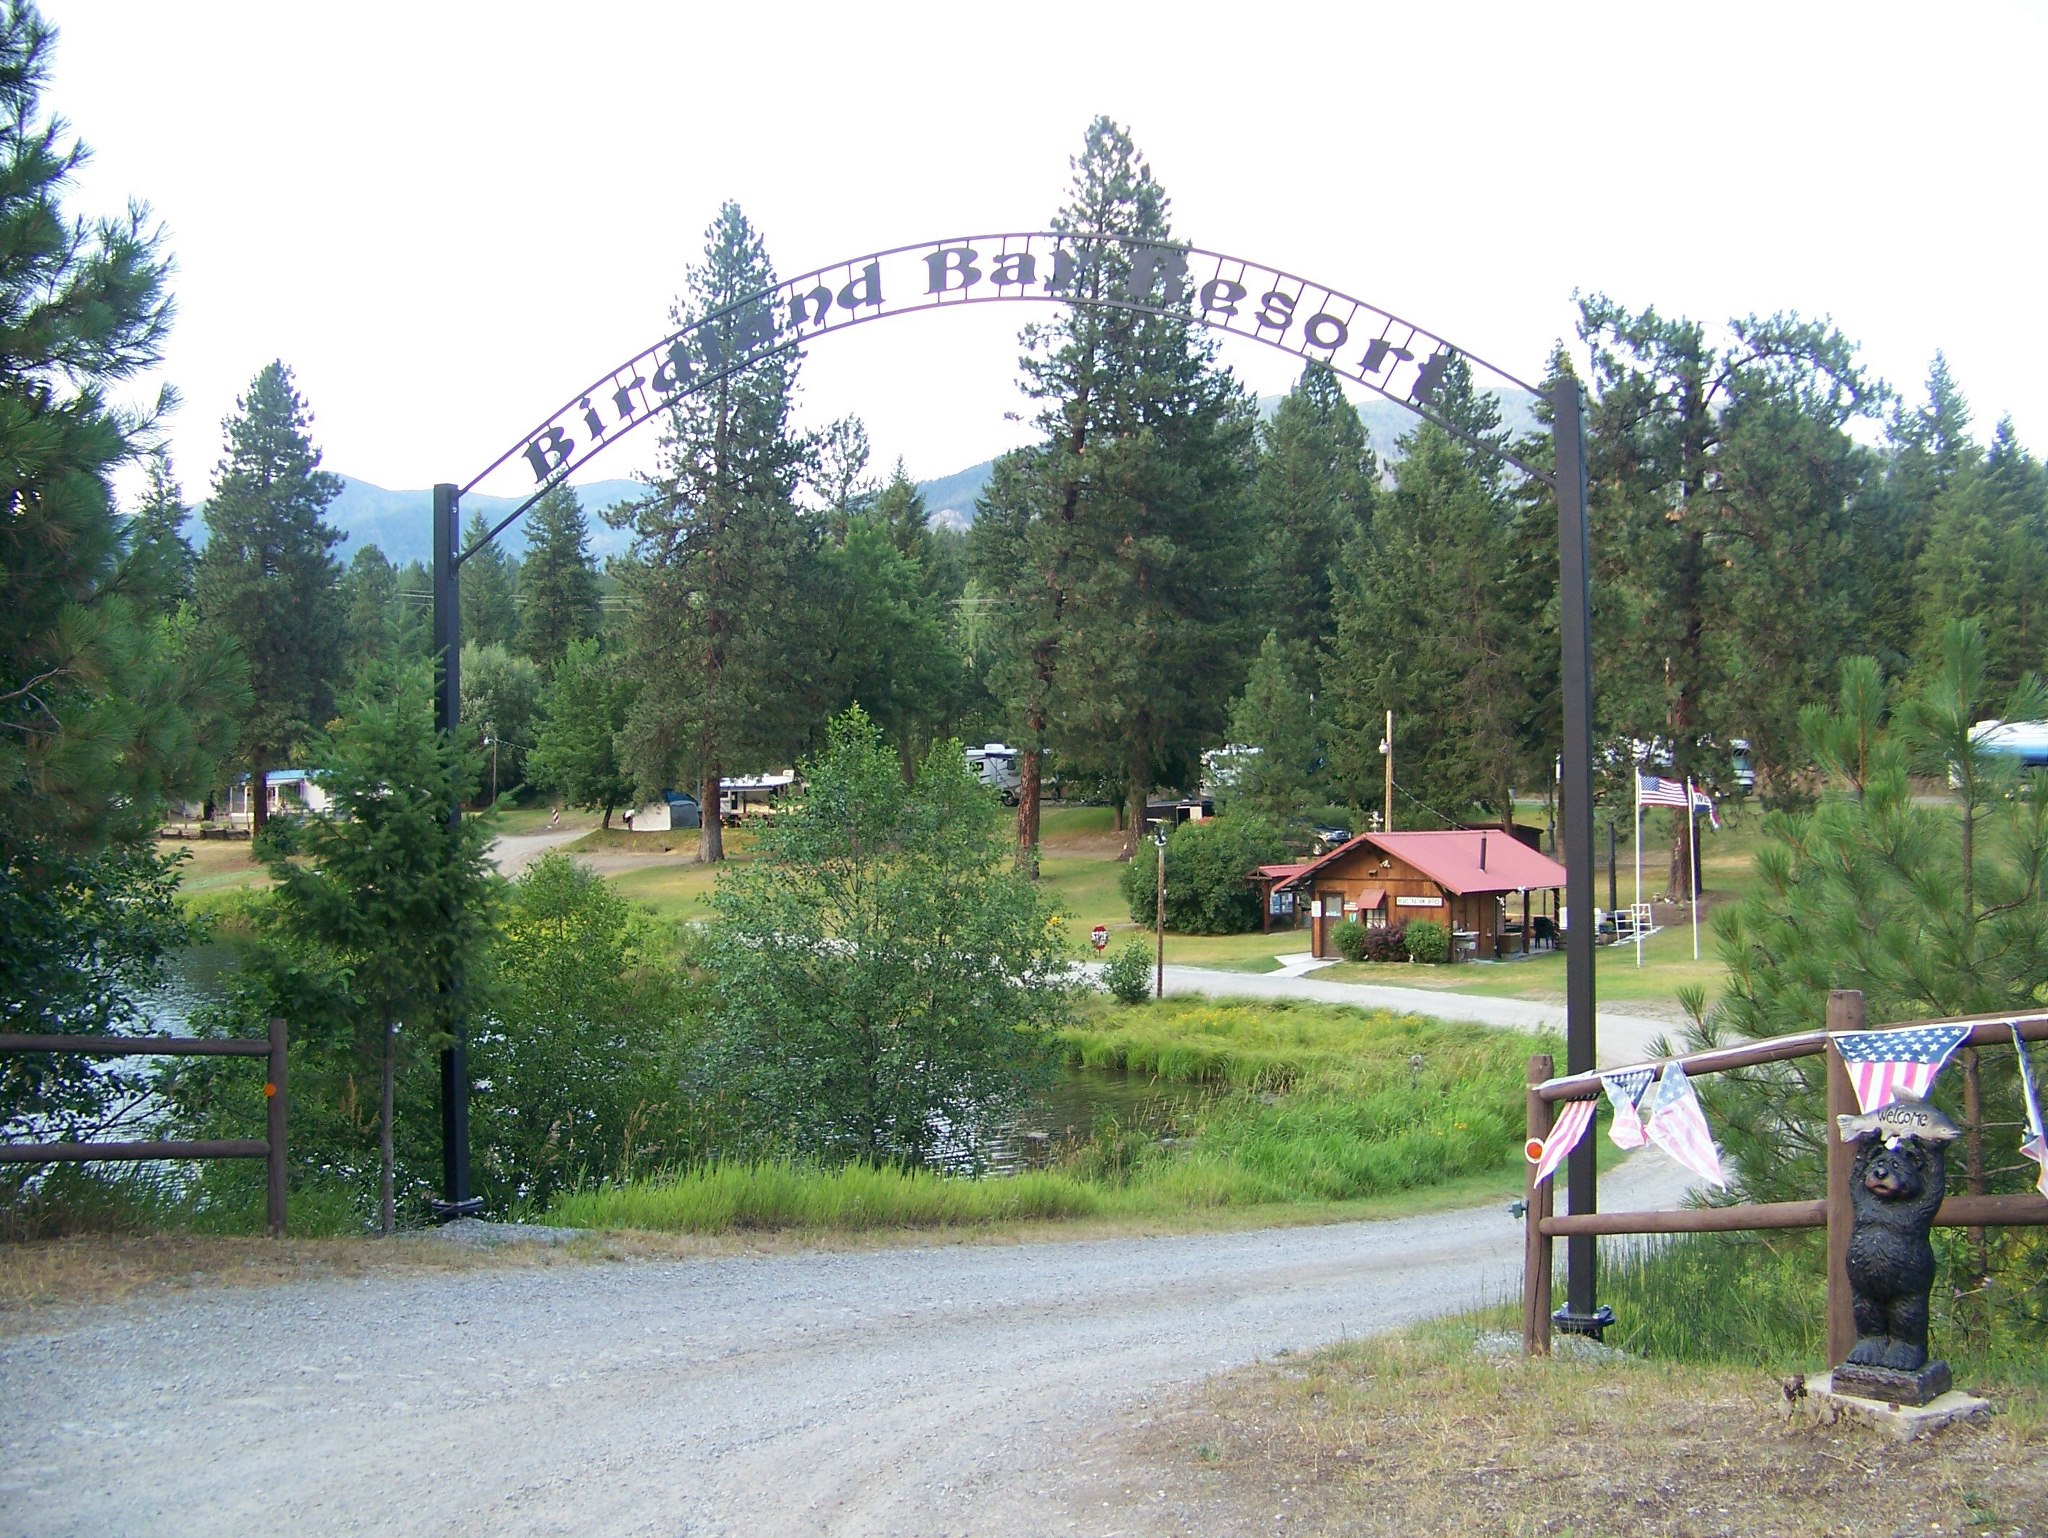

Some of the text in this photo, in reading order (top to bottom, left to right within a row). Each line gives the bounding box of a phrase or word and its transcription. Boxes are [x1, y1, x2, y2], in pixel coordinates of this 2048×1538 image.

[922, 246, 1105, 295] Bay
[1123, 246, 1453, 408] Resort
[1877, 1106, 1929, 1127] Welcome
